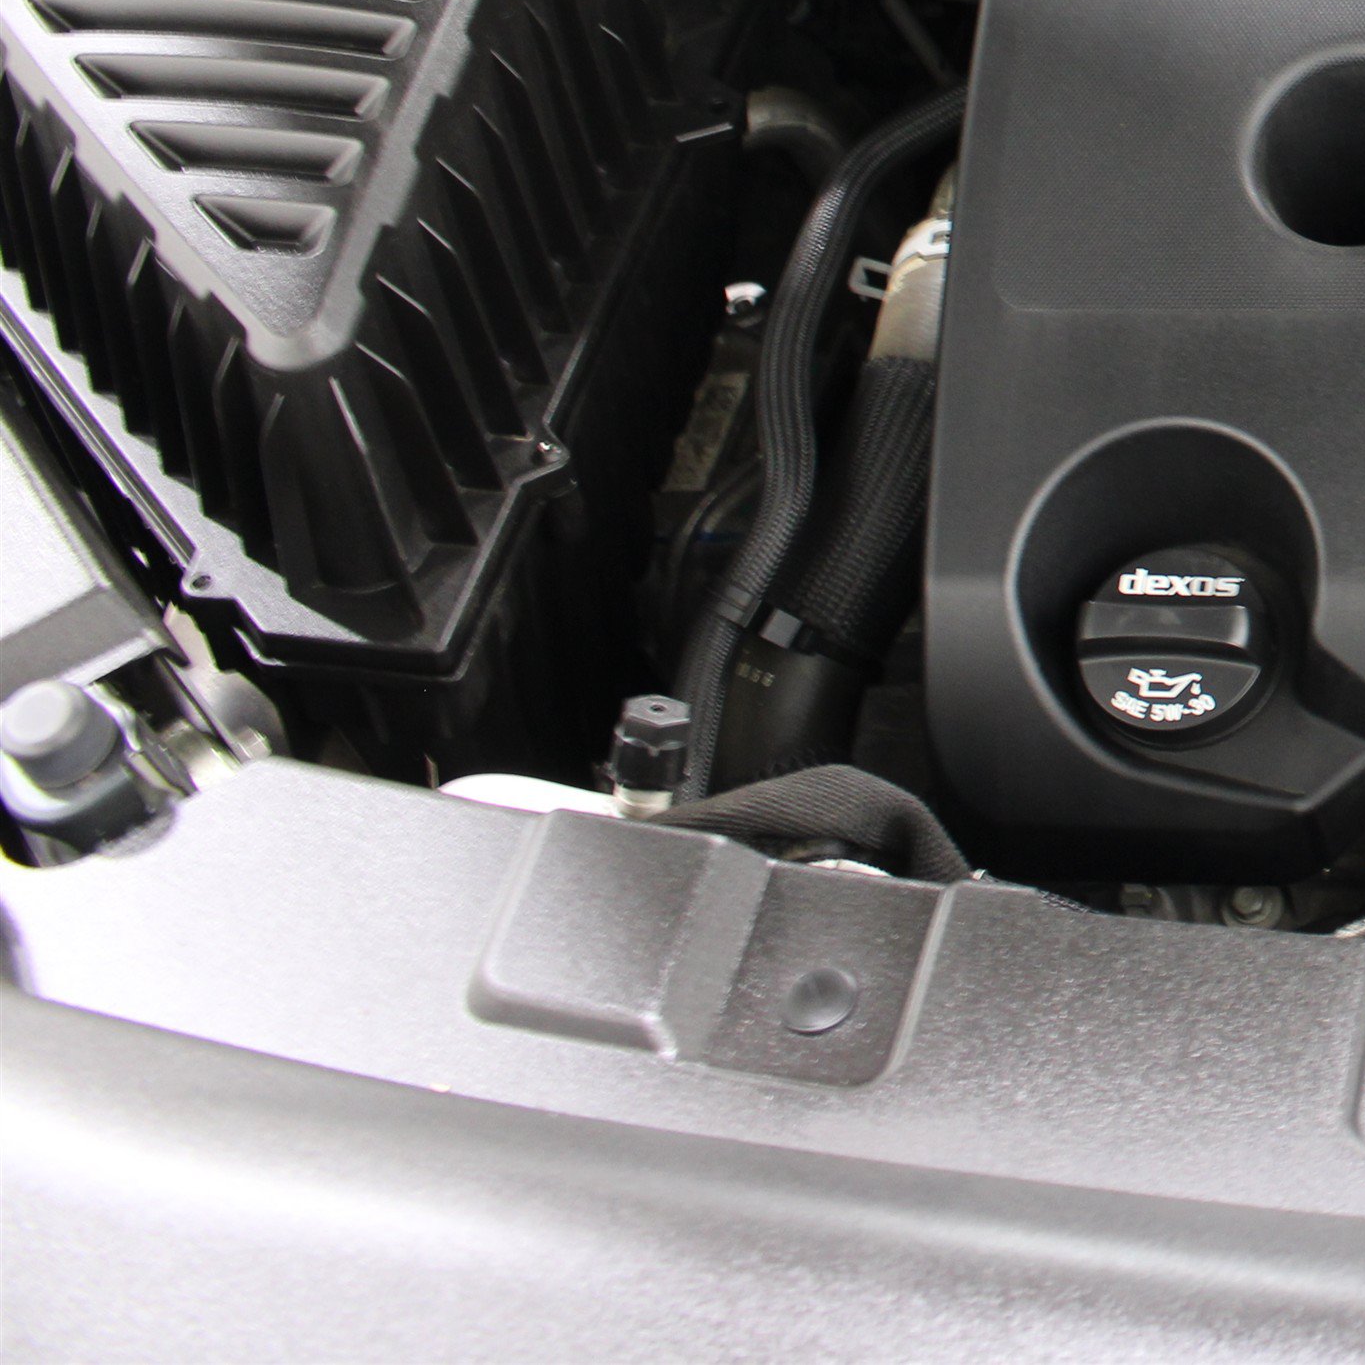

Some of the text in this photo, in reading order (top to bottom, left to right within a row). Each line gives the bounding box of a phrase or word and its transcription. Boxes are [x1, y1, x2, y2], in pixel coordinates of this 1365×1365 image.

[1118, 567, 1243, 597] dexos
[1110, 690, 1217, 722] SAE 5W-30
